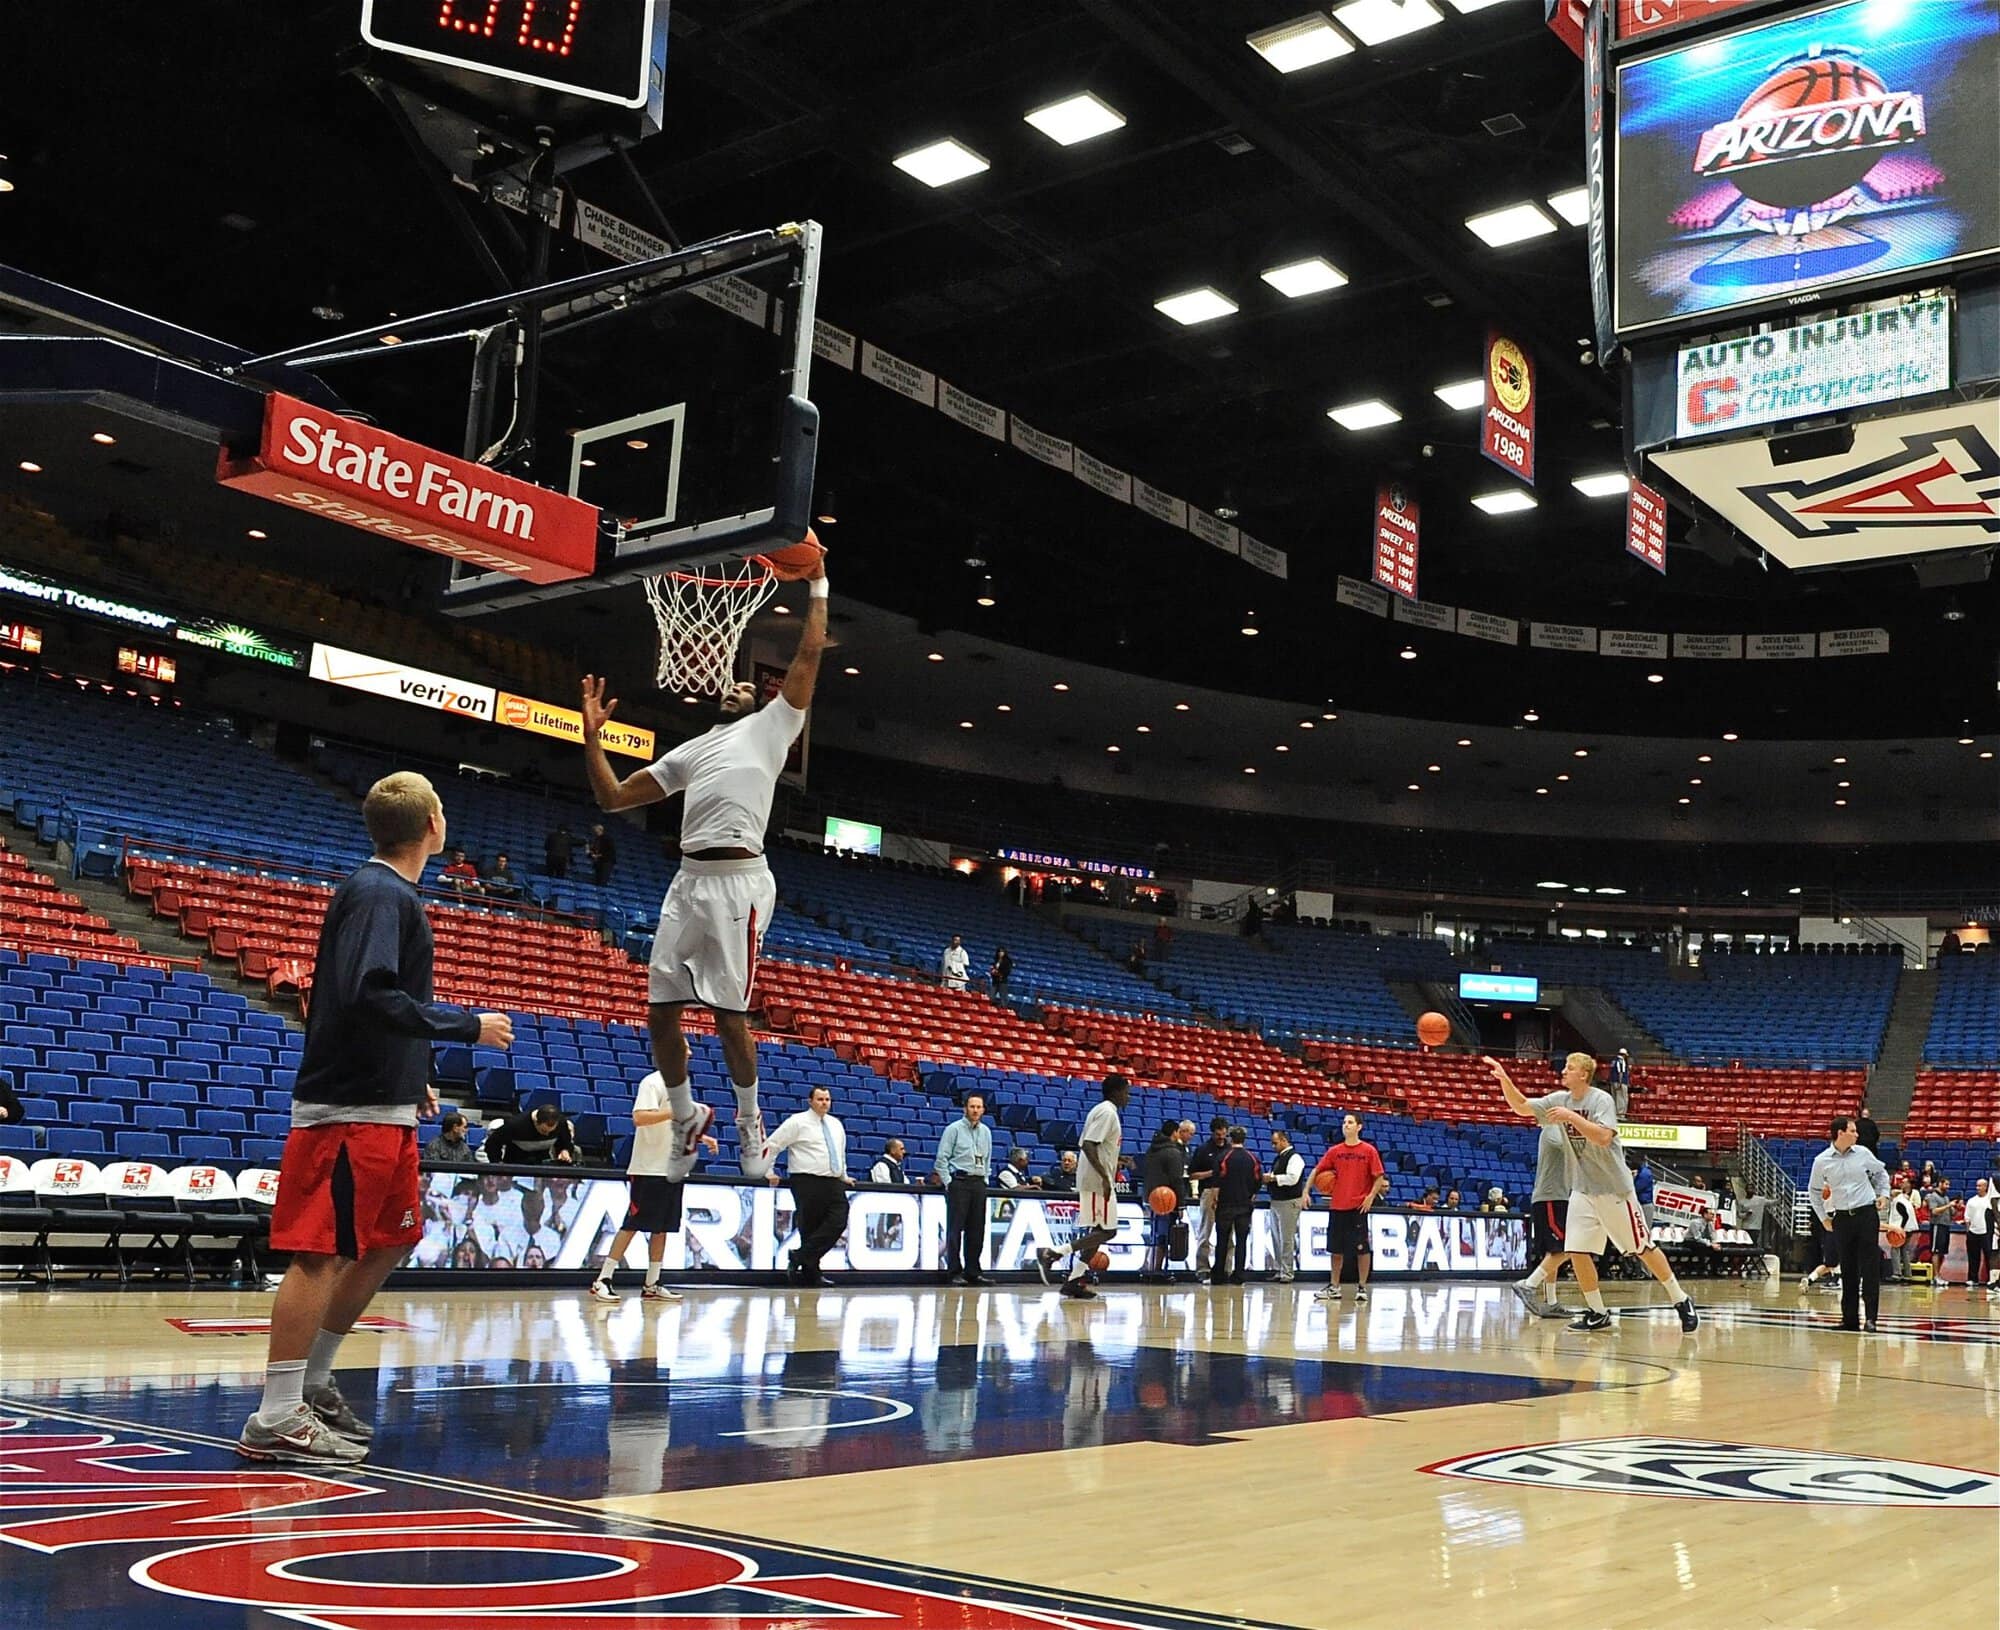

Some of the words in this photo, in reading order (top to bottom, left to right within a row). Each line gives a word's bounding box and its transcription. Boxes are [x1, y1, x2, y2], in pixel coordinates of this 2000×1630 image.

[1703, 96, 1922, 168] ARIZONA
[584, 206, 616, 230] CHASE
[618, 222, 665, 254] BUDINGER
[1683, 335, 1775, 374] AUTO
[1788, 302, 1945, 354] INJURY?
[1745, 361, 1931, 413] Chiropractic
[1488, 406, 1530, 443] ARIZONA
[1493, 433, 1524, 466] 1988
[1632, 491, 1654, 512] SWEET
[1380, 506, 1416, 534] ARIZONA
[1380, 527, 1404, 547] SWEET
[177, 628, 223, 650] BRIGHT
[225, 641, 296, 667] SOLUTIONS
[399, 678, 487, 713] verizon
[533, 712, 581, 734] Lifetime
[1009, 852, 1071, 868] ARIZONA
[1077, 860, 1143, 878] WILDCATS
[1619, 1127, 1675, 1139] UNSTREET
[55, 1162, 83, 1184] 2K
[124, 1165, 151, 1185] 2K
[190, 1168, 215, 1188] 2K
[51, 1181, 81, 1190] SPORTS
[121, 1183, 148, 1192] SPORTS
[188, 1186, 213, 1195] SPORTS
[255, 1189, 277, 1198] SPORT
[1655, 1190, 1707, 1215] ESPN
